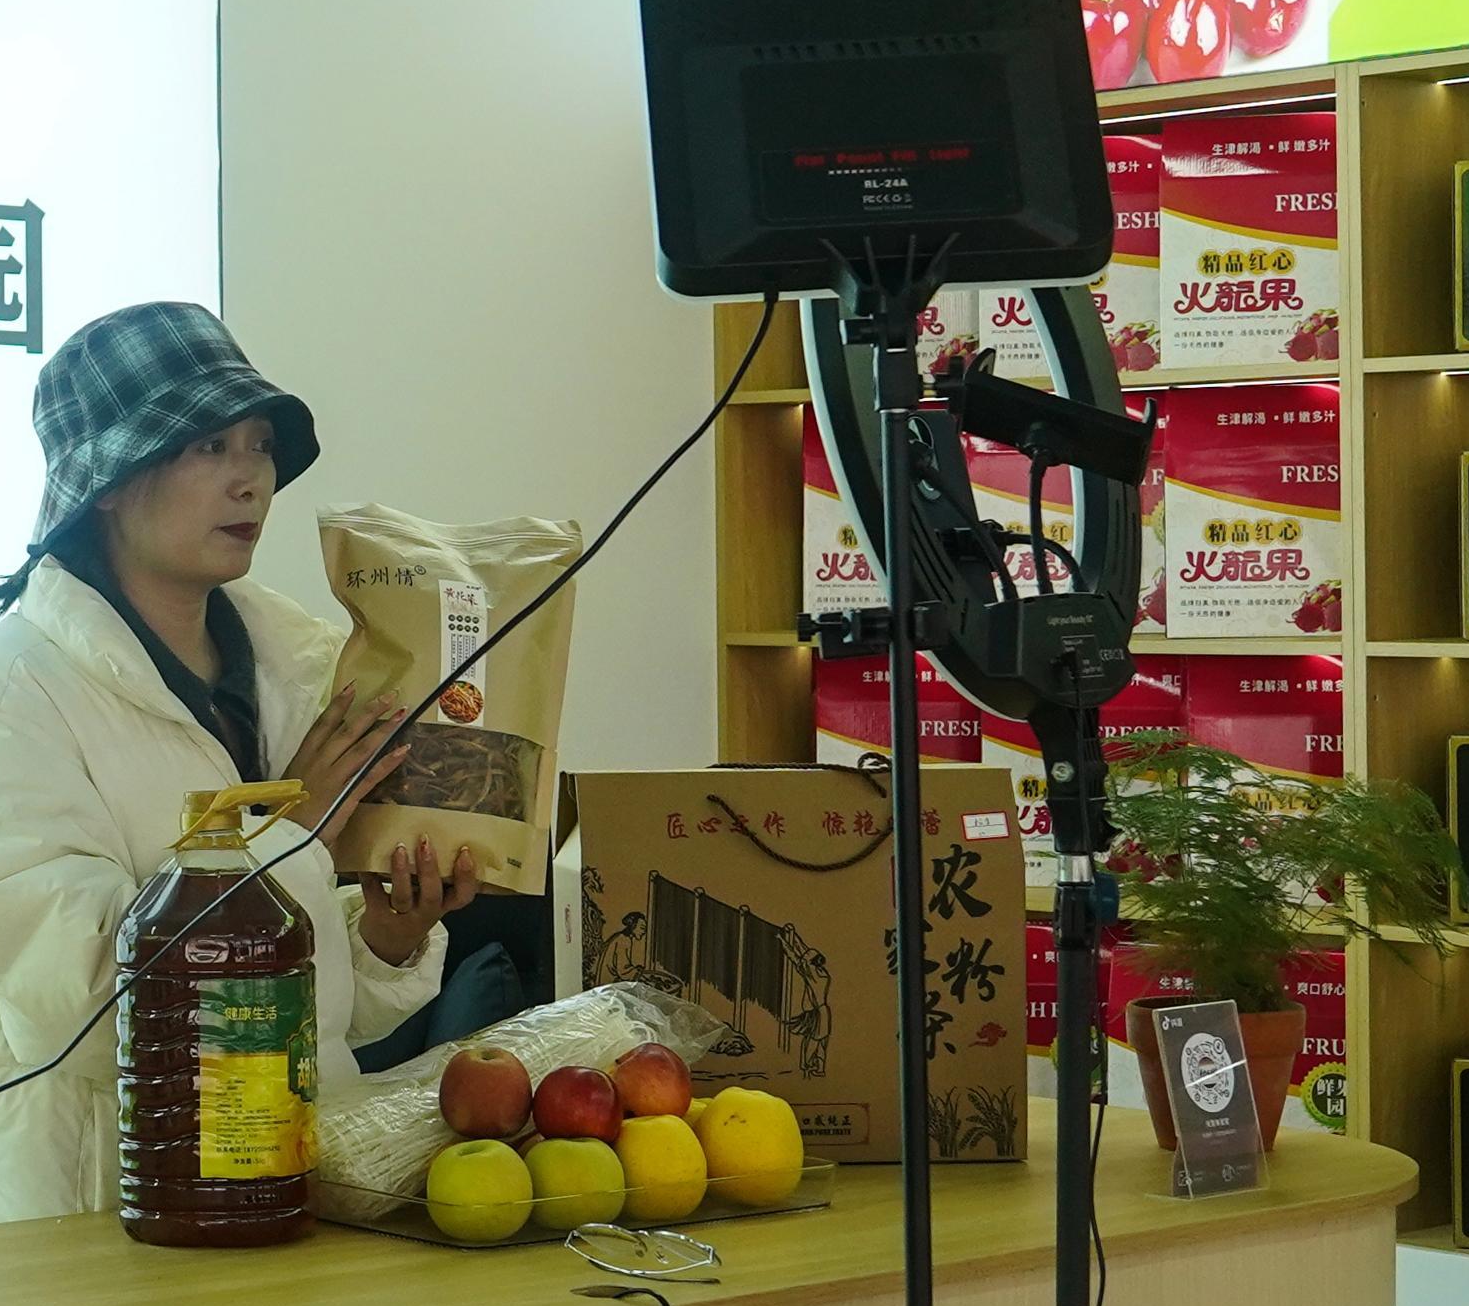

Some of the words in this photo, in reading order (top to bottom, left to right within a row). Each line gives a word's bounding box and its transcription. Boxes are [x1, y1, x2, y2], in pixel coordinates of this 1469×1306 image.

[1275, 193, 1338, 212] FRES
[1201, 253, 1293, 273] 精品红心
[1208, 524, 1298, 544] 精品红心
[822, 809, 942, 837] 惊艳蕾
[224, 1005, 278, 1021] 健康生活
